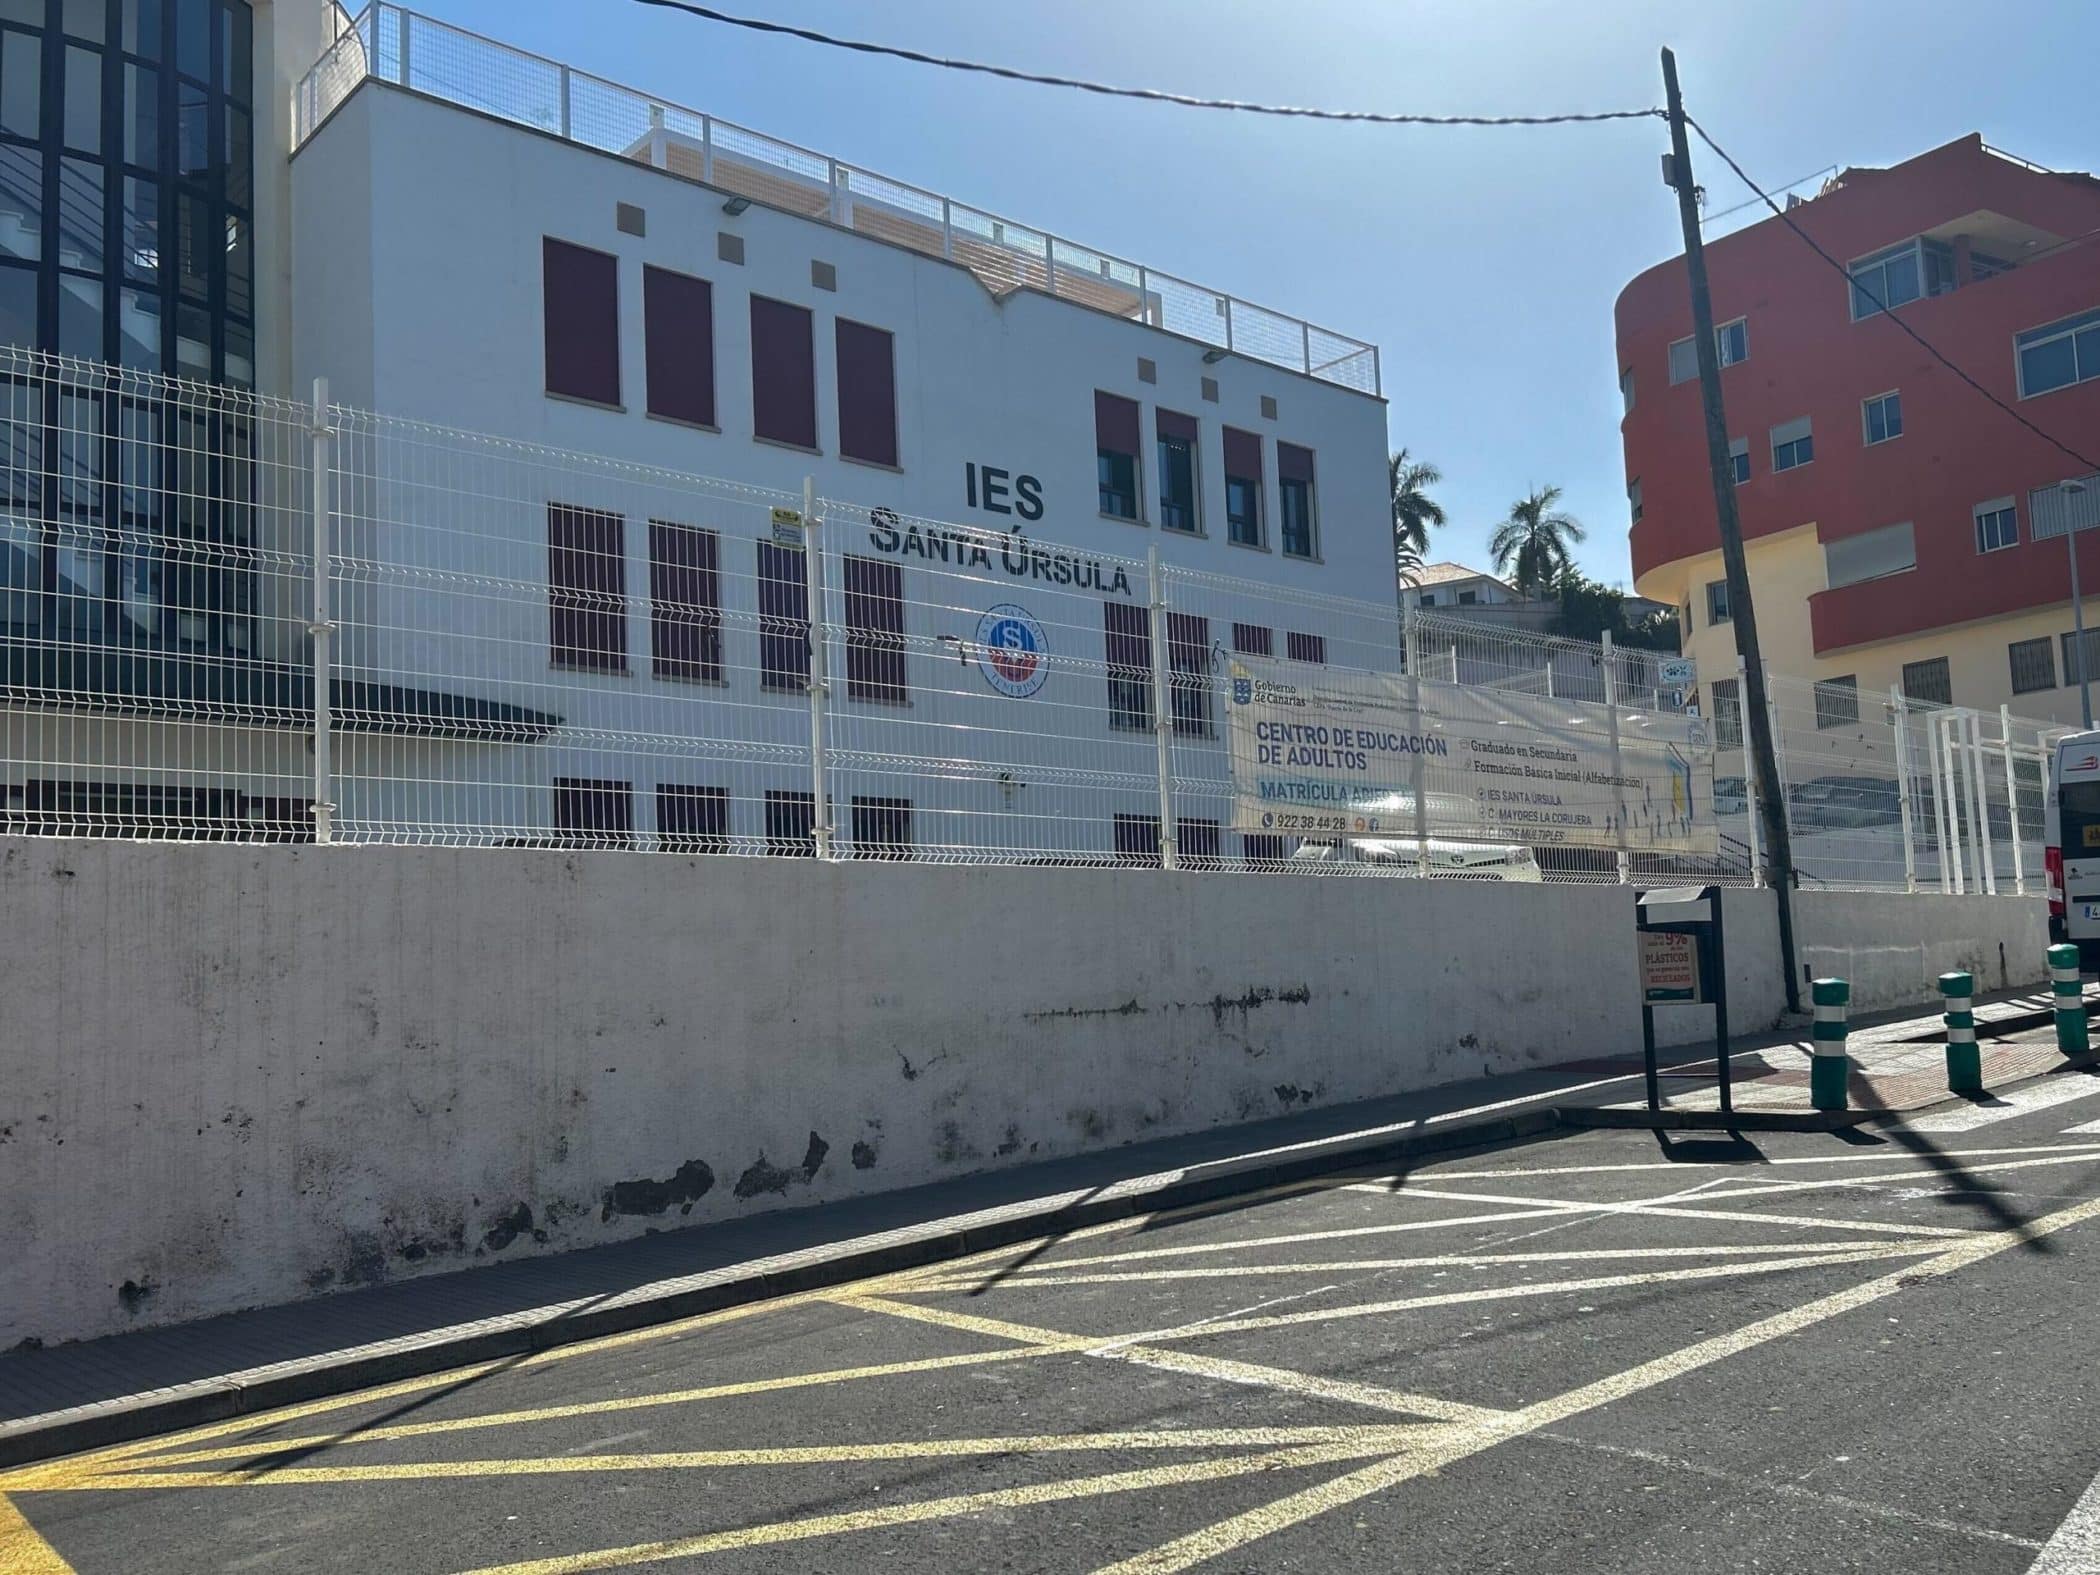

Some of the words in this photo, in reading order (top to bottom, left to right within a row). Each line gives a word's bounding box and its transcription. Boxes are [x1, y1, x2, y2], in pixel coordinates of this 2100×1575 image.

[966, 462, 1044, 520] IES
[869, 506, 993, 570] SANTA
[1000, 525, 1132, 596] ÚRSULA
[1254, 680, 1296, 694] Gobierno
[1254, 691, 1267, 703] de
[1267, 692, 1306, 707] Canarias
[1256, 721, 1329, 745] CENTRO
[1333, 727, 1354, 748] DE
[1356, 730, 1448, 757] EDUCACIÓN
[1258, 744, 1282, 765] DE
[1287, 746, 1367, 770] ADULTOS
[1471, 740, 1516, 756] Graduado
[1517, 747, 1528, 757] en
[1530, 747, 1577, 762] Secundaria
[1473, 760, 1523, 775] Formación
[1555, 769, 1581, 783] Inicial
[1260, 779, 1348, 802] MATRÍCULA
[1487, 789, 1500, 801] IES
[1502, 790, 1530, 804] SANTA
[1277, 814, 1298, 829] 922
[1300, 815, 1314, 830] 38
[1316, 816, 1330, 830] 44
[1332, 817, 1346, 830] 28
[1499, 808, 1538, 822] MAYORES
[1540, 811, 1550, 823] LA
[1645, 951, 1689, 964] PLÁSTICOS
